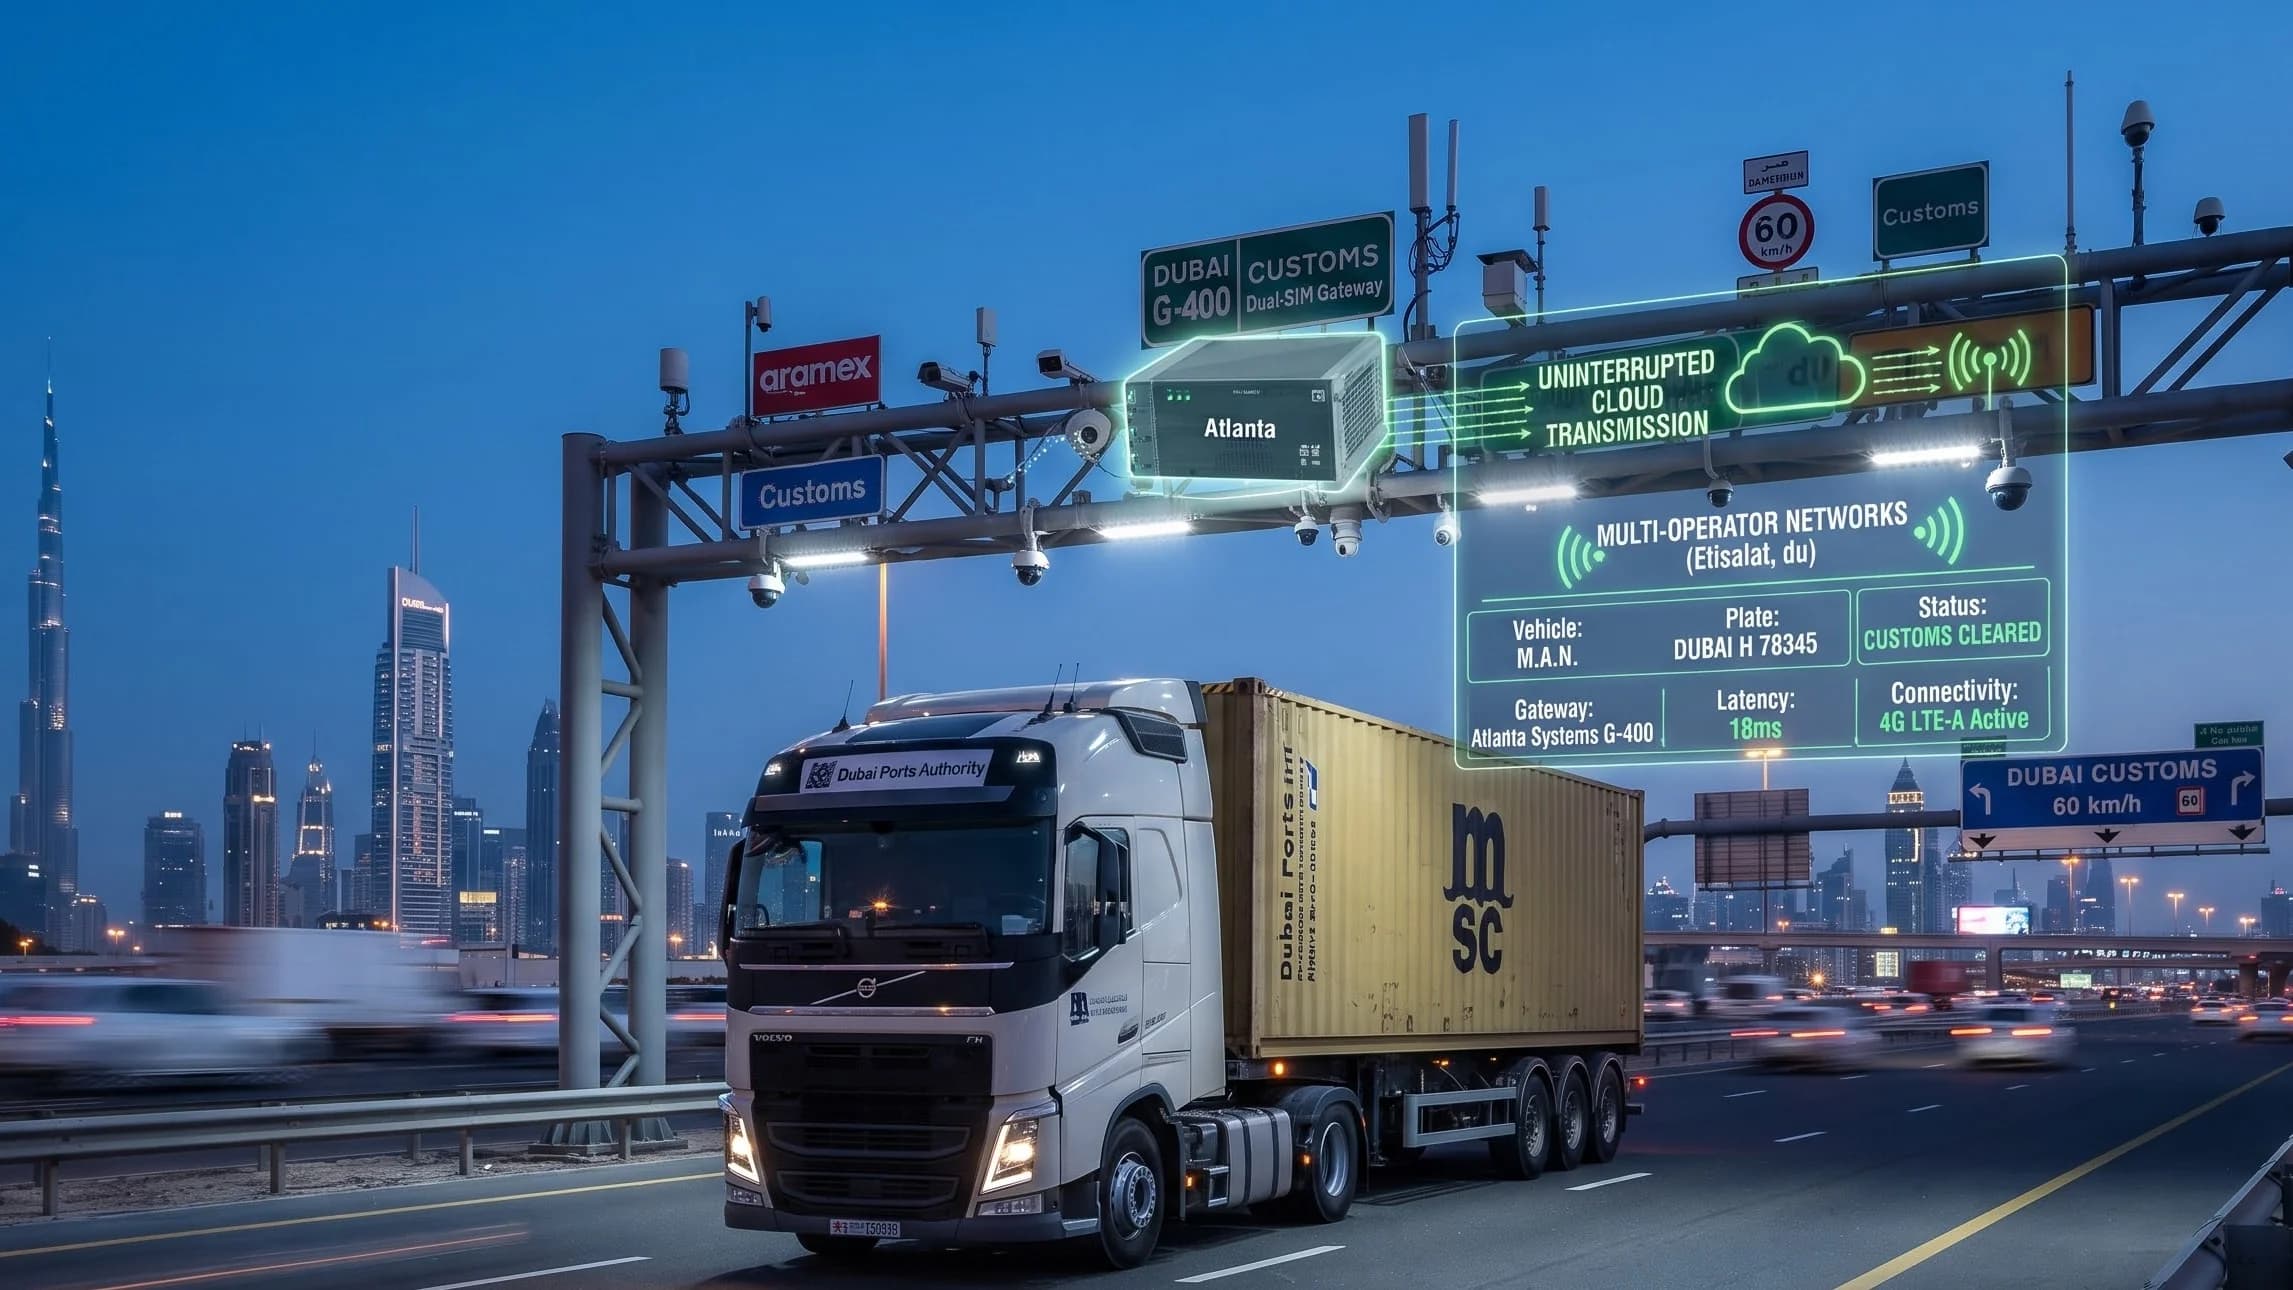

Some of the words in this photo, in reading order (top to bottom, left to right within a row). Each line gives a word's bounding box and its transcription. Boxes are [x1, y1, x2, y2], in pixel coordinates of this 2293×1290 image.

[1754, 212, 1799, 243] 60
[1882, 197, 1979, 227] Customs
[1248, 243, 1379, 285] CUSTOMS
[1760, 242, 1793, 258] km/h
[1153, 254, 1229, 288] DUBAI
[1152, 286, 1231, 327] G-400
[1246, 281, 1314, 313] Dual-SIM
[1316, 279, 1384, 304] Gateway
[759, 356, 872, 391] aramex
[1203, 418, 1276, 439] Atlanta
[759, 477, 866, 509] Customs
[837, 766, 878, 782] Dubai
[879, 764, 917, 780] Ports
[919, 760, 985, 780] Authority
[2007, 766, 2084, 787] DUBAI
[2091, 758, 2218, 784] CUSTOMS
[2053, 798, 2079, 815] 60
[2088, 794, 2142, 815] km/h
[2181, 795, 2198, 808] 60
[1279, 891, 1294, 981] Dubai
